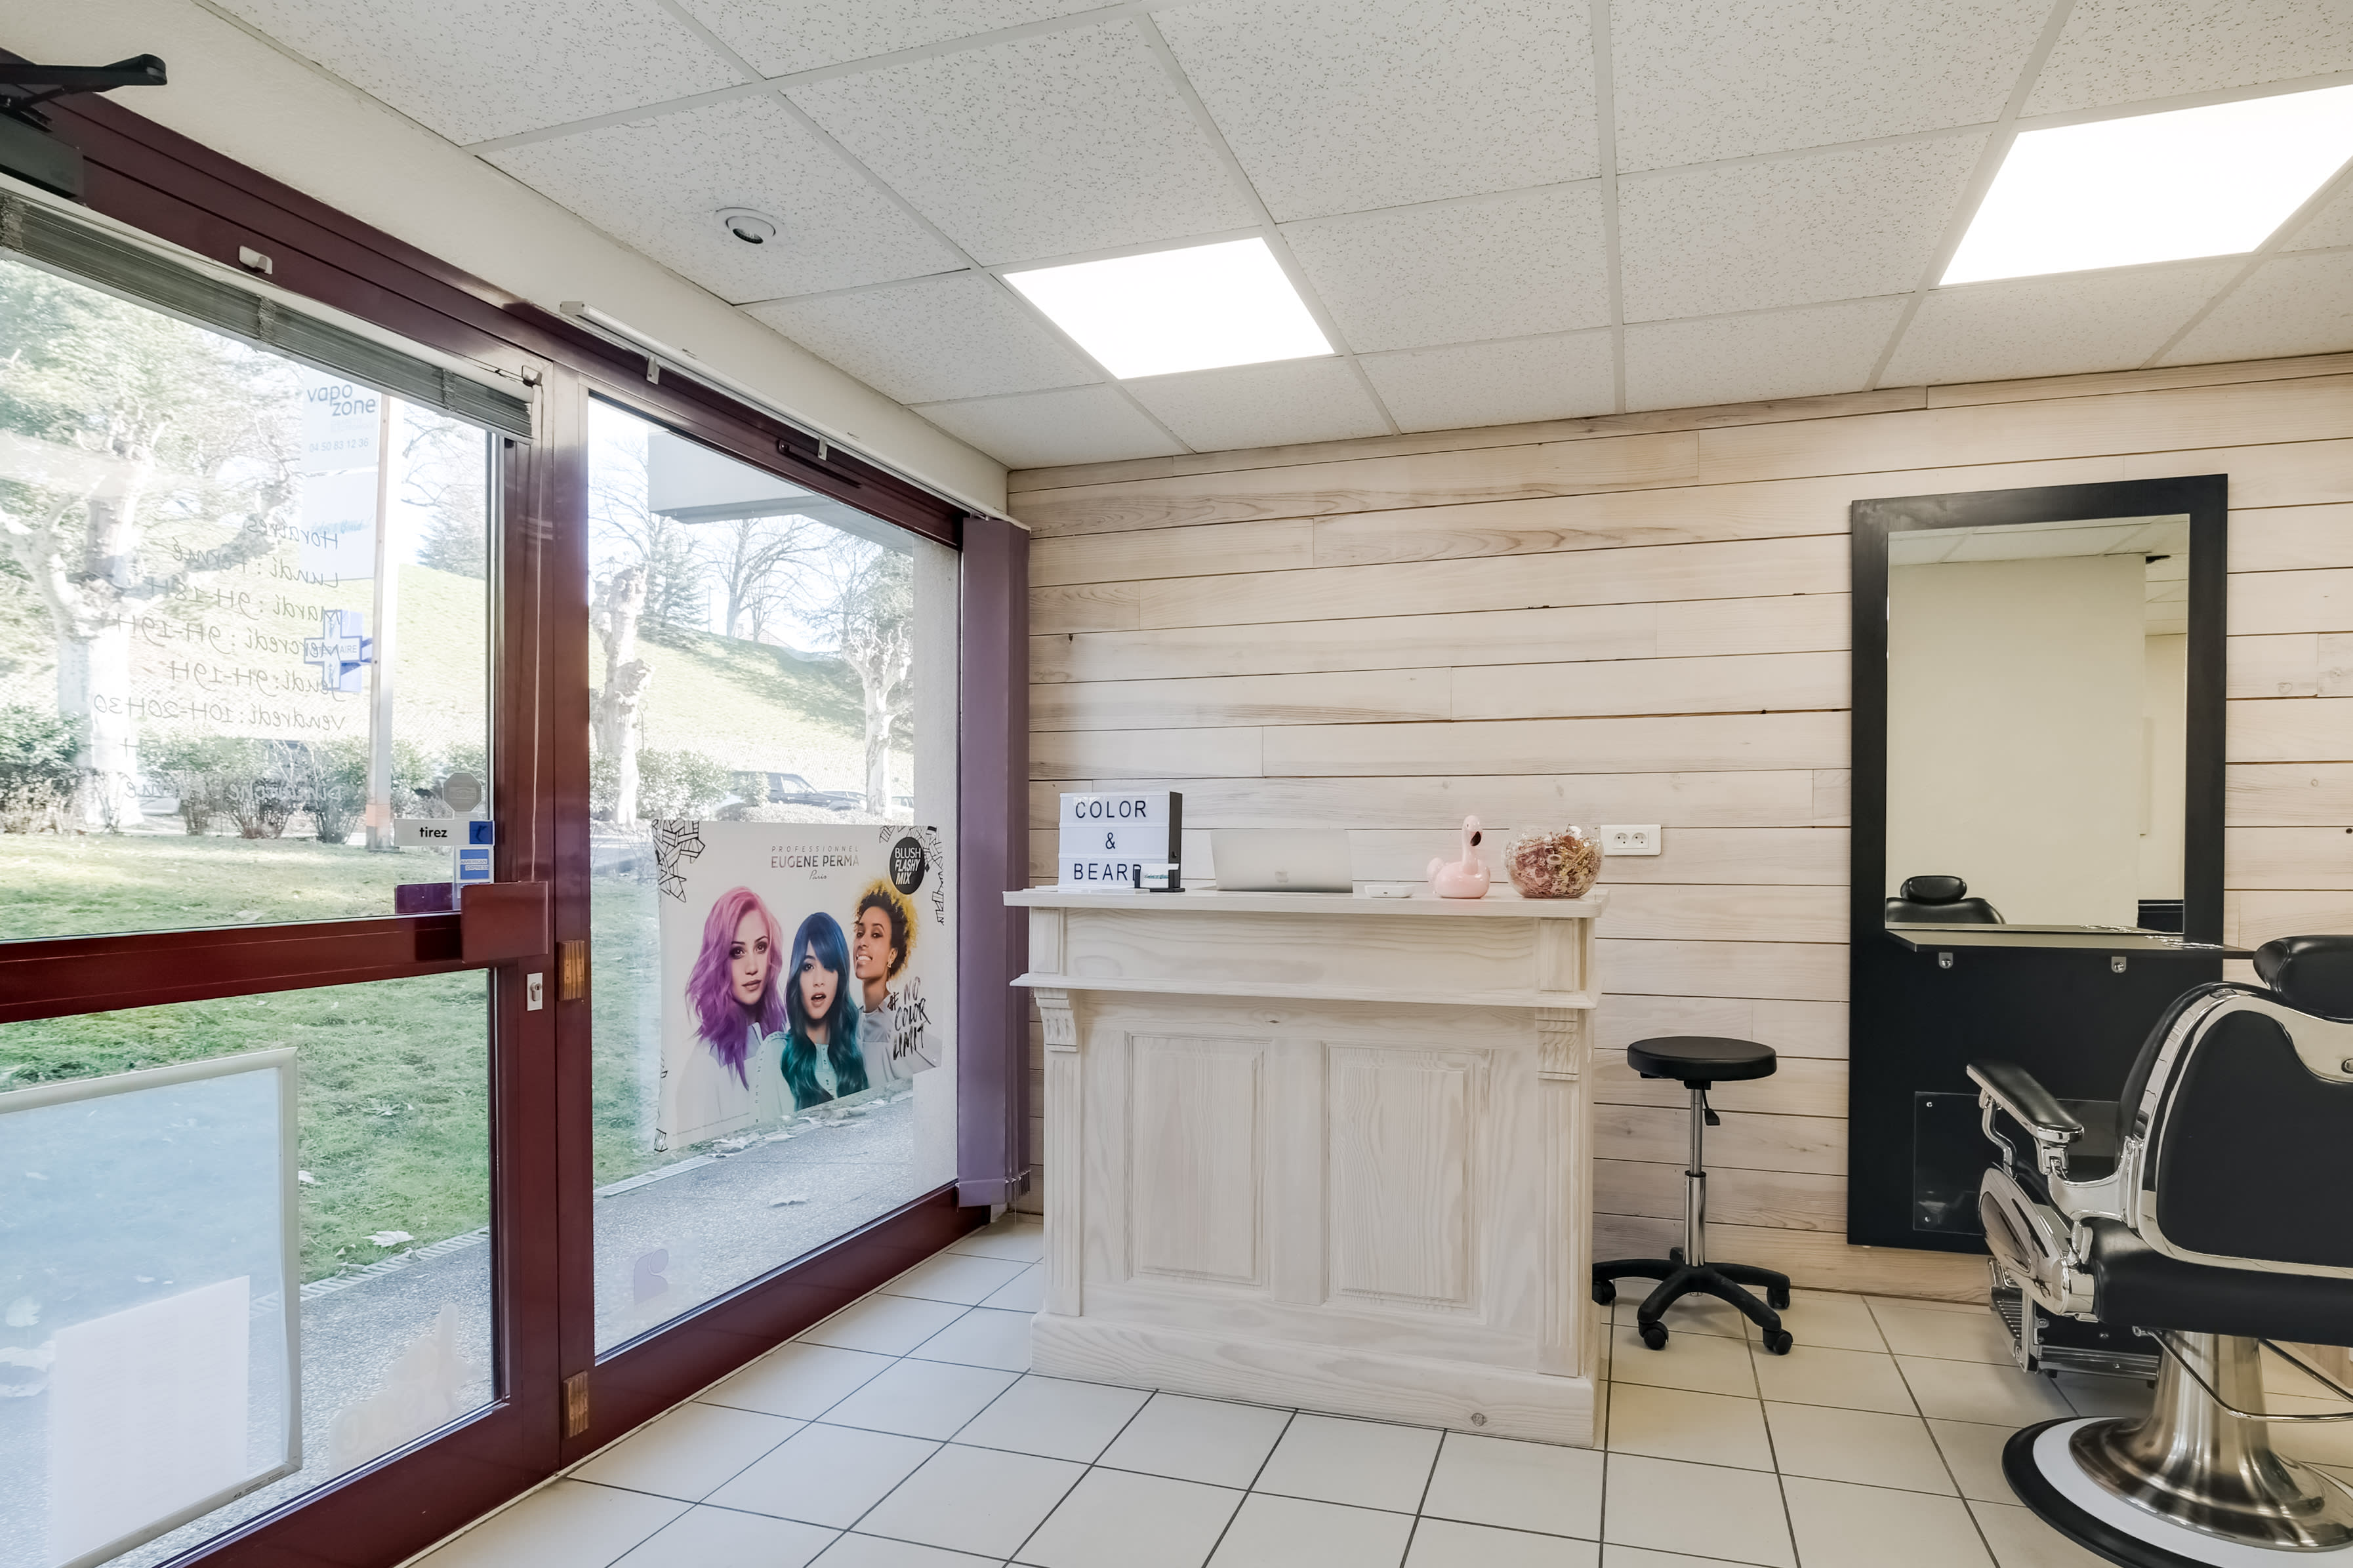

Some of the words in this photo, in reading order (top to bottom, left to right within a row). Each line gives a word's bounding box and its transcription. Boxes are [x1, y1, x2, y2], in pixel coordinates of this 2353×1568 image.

[307, 384, 353, 407] vapo
[331, 398, 377, 416] zone
[321, 442, 331, 452] 50
[346, 439, 356, 449] 12
[358, 437, 369, 447] 36
[1075, 800, 1147, 818] COLOR
[419, 826, 448, 838] tirez
[1105, 832, 1116, 850] &
[895, 847, 922, 859] BLUSH
[771, 855, 819, 868] EUGENE
[822, 854, 860, 867] PERMA
[895, 858, 921, 872] FLASHY
[809, 870, 827, 880] Paris
[895, 872, 912, 885] MIX
[895, 997, 931, 1032] COLOR
[893, 1021, 926, 1060] LIMIT
